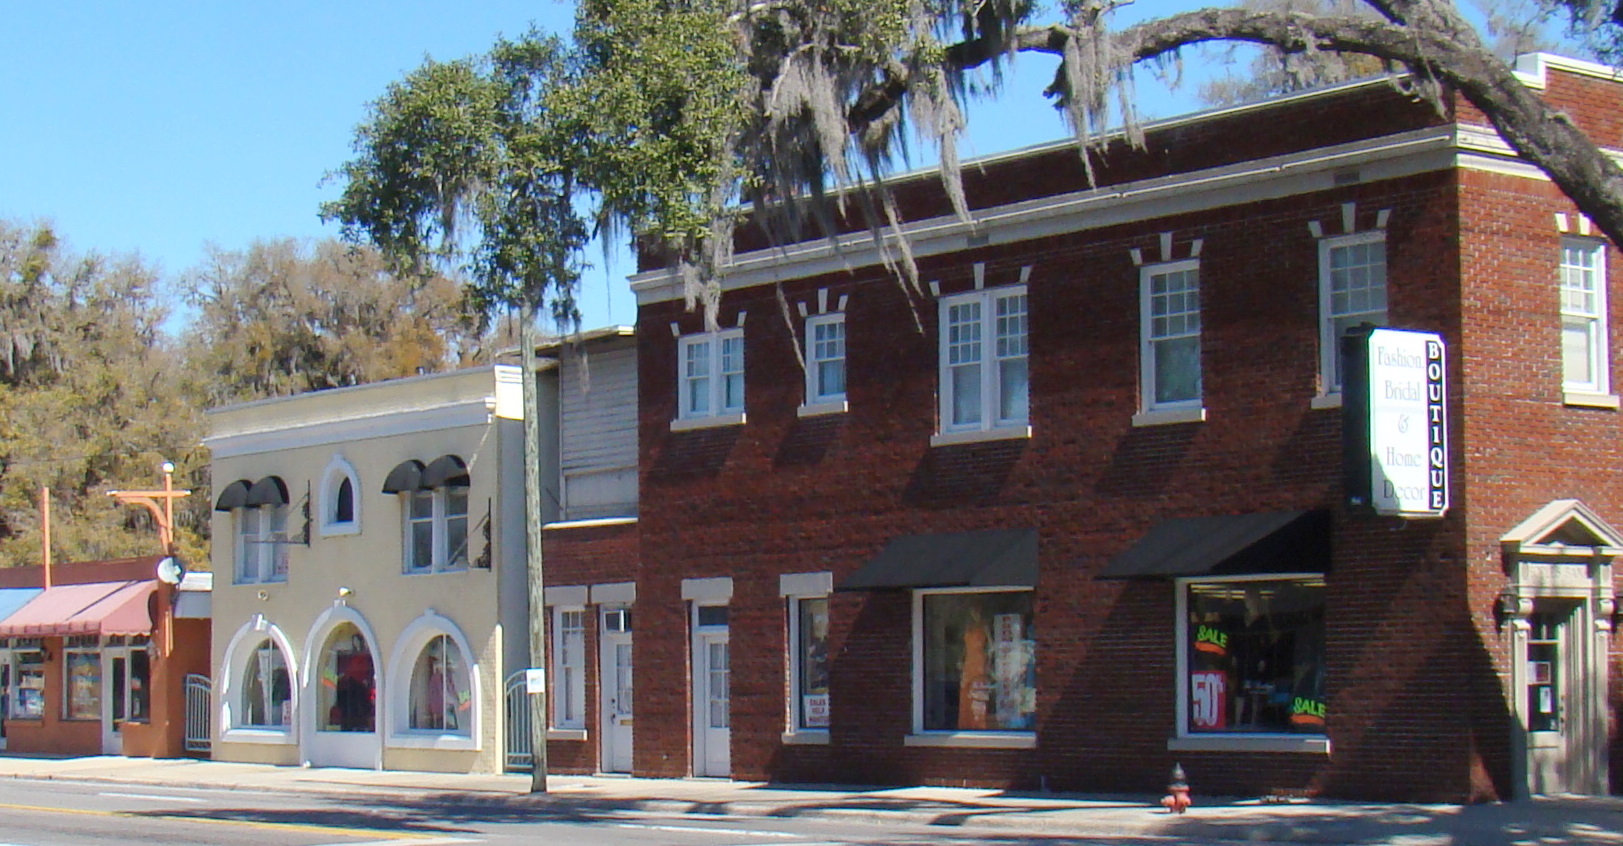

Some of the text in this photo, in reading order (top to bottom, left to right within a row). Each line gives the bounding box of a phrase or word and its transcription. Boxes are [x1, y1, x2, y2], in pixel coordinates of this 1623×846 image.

[1385, 380, 1420, 401] Bridal
[1398, 414, 1409, 433] &
[1428, 342, 1444, 508] BOUTIQUE
[1386, 447, 1421, 467] Home
[1197, 625, 1228, 647] SALE
[1293, 697, 1326, 717] SALE
